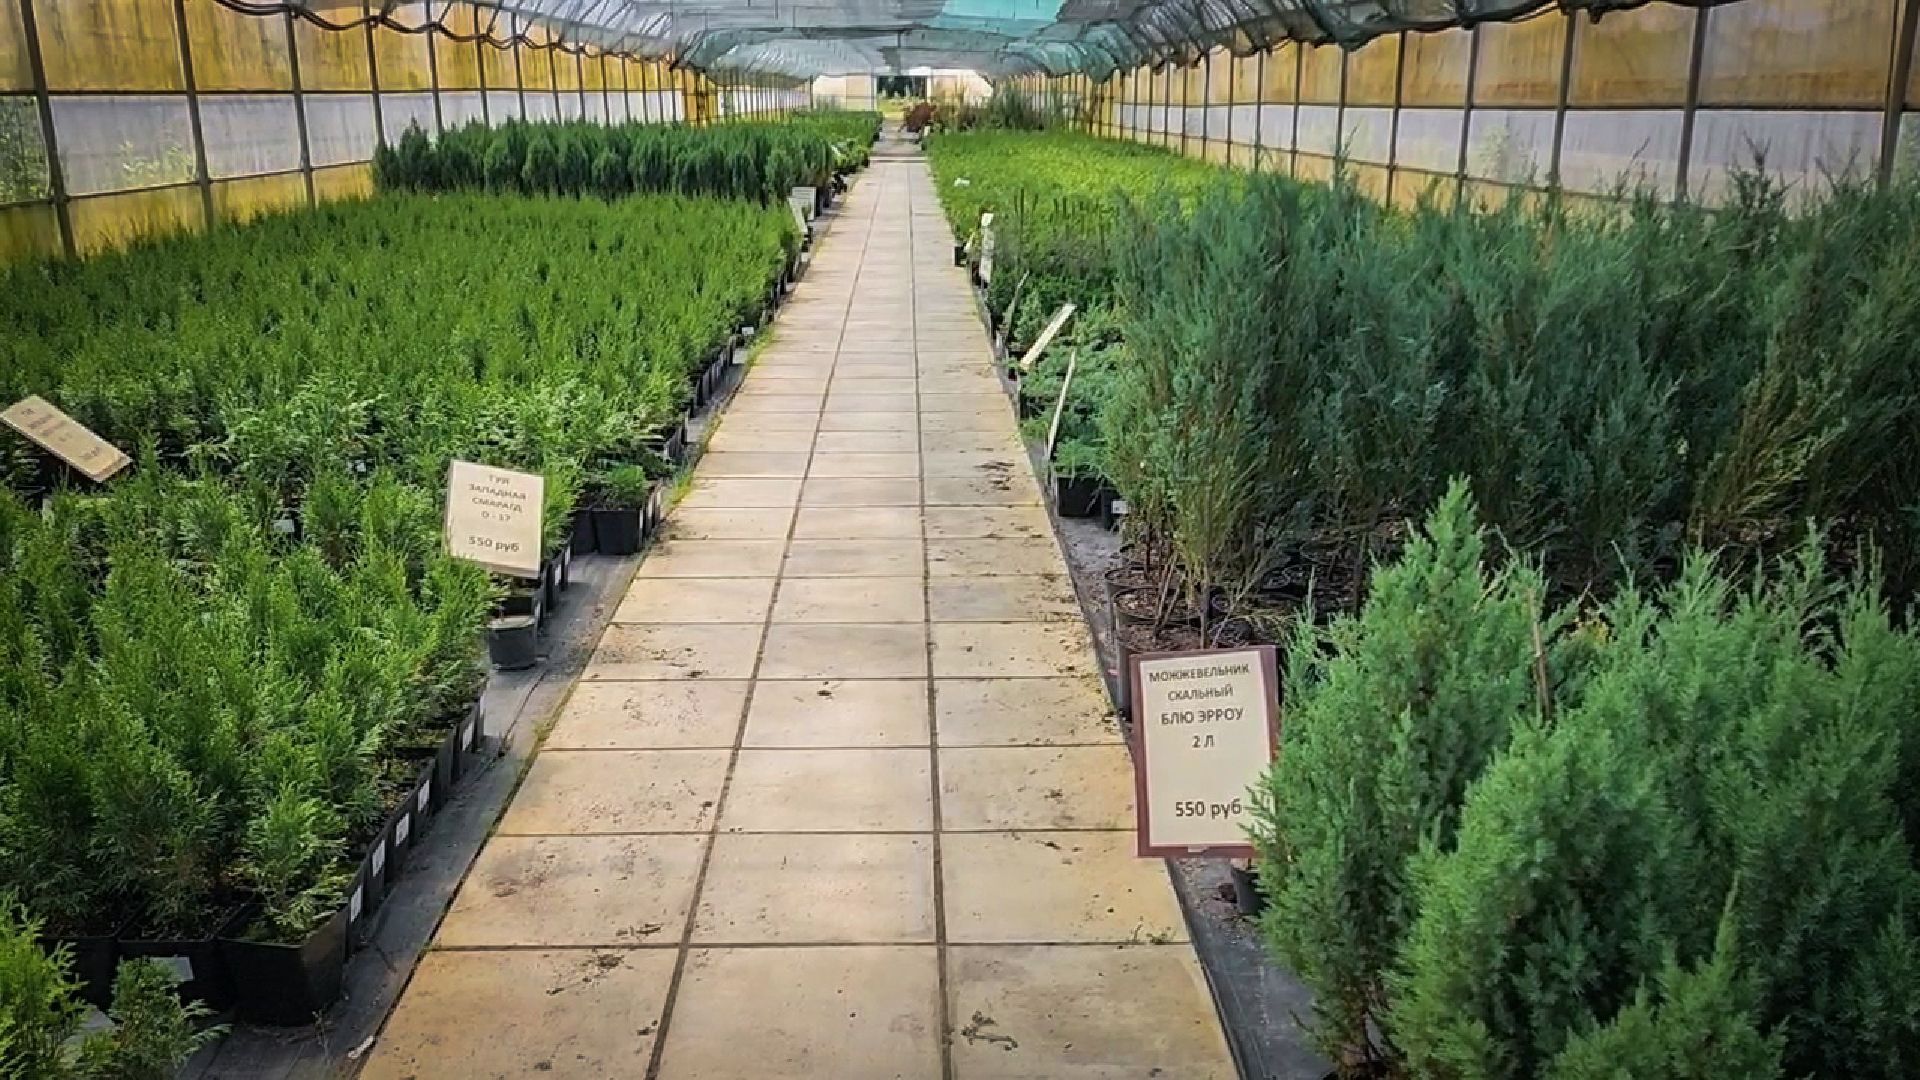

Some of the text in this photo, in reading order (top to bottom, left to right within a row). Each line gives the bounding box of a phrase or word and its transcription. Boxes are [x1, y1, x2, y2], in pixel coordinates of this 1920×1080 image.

[469, 483, 527, 500] ЗАПАДНАЯ
[472, 497, 523, 513] СМАРАГД
[469, 536, 520, 553] 550 руб
[1149, 663, 1249, 682] МОЖЖЕВЕЛЬНИК
[1167, 684, 1234, 702] СКАЛЬНЫЙ
[1161, 707, 1244, 725] БЛЮ ЭРРОУ
[1191, 735, 1215, 748] 2 Л
[1175, 798, 1242, 820] 550 руб
